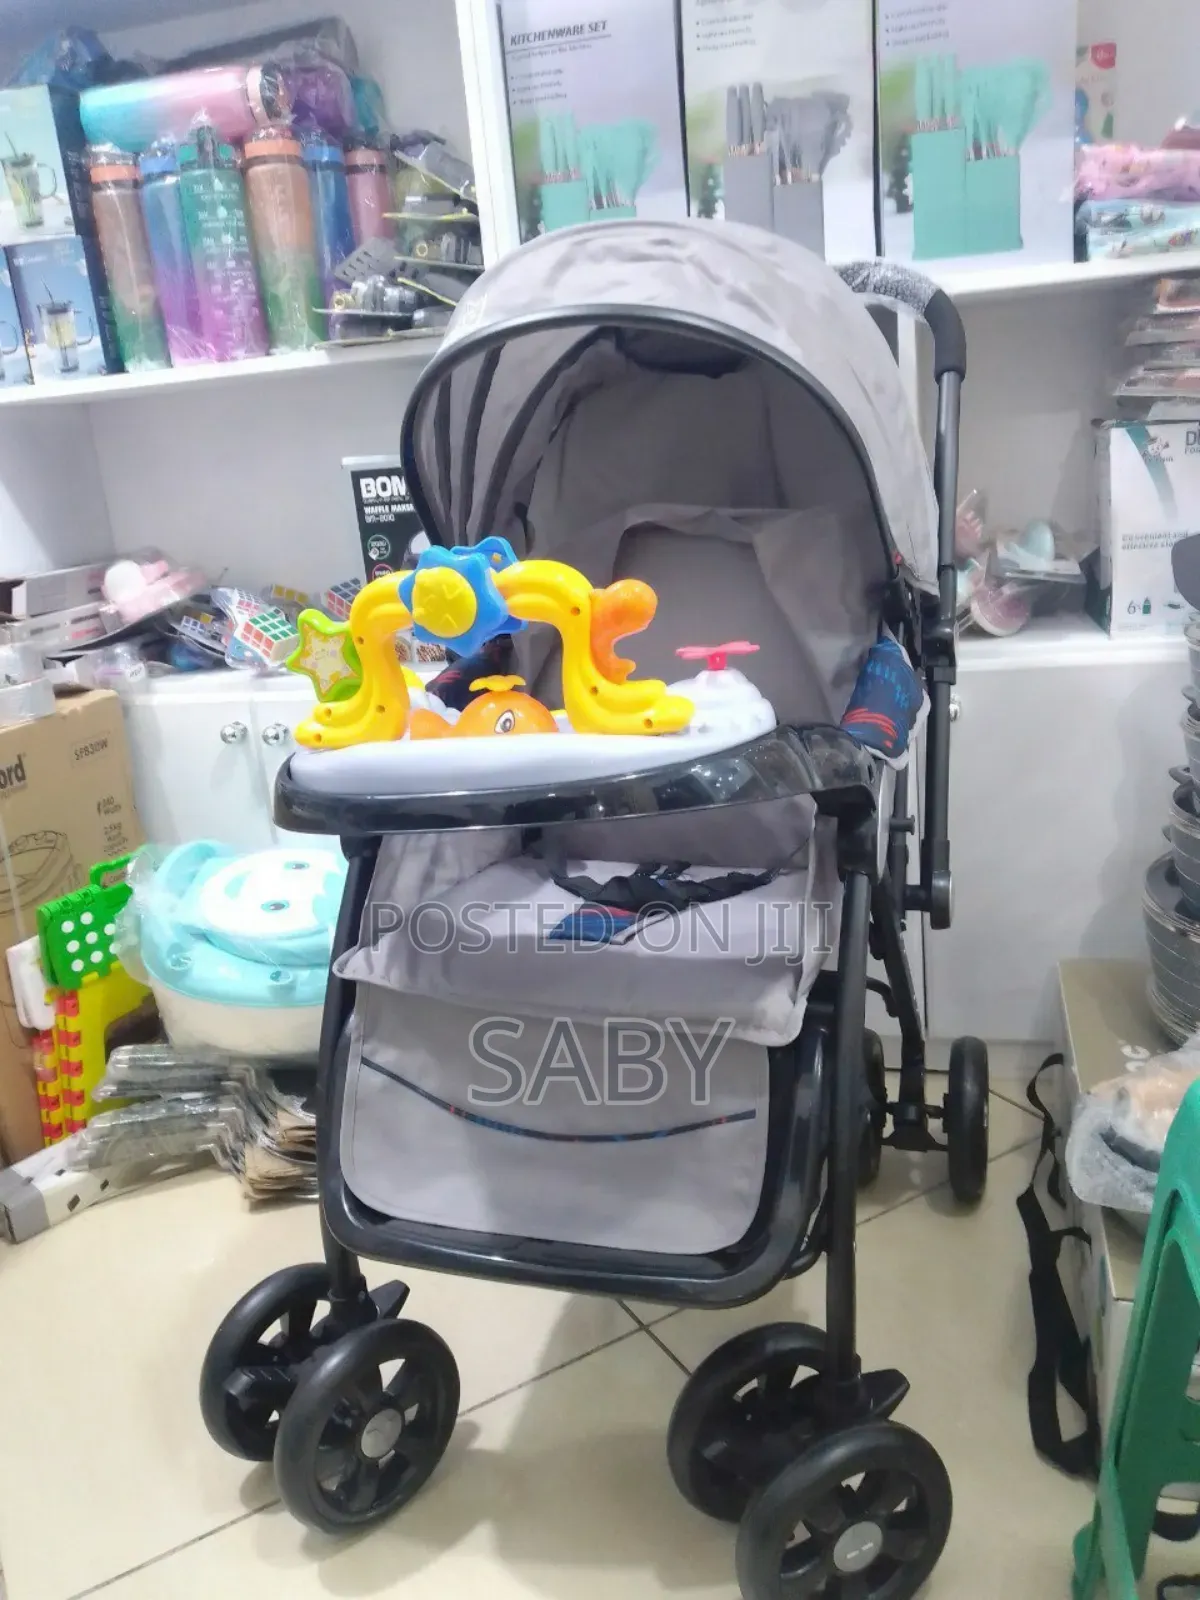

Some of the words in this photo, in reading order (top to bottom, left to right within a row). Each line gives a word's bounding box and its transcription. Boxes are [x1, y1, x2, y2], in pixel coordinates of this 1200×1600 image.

[510, 23, 585, 46] KITCHENWARE
[588, 20, 607, 32] SET
[1185, 429, 1200, 446] D
[363, 505, 389, 514] WAFFLE
